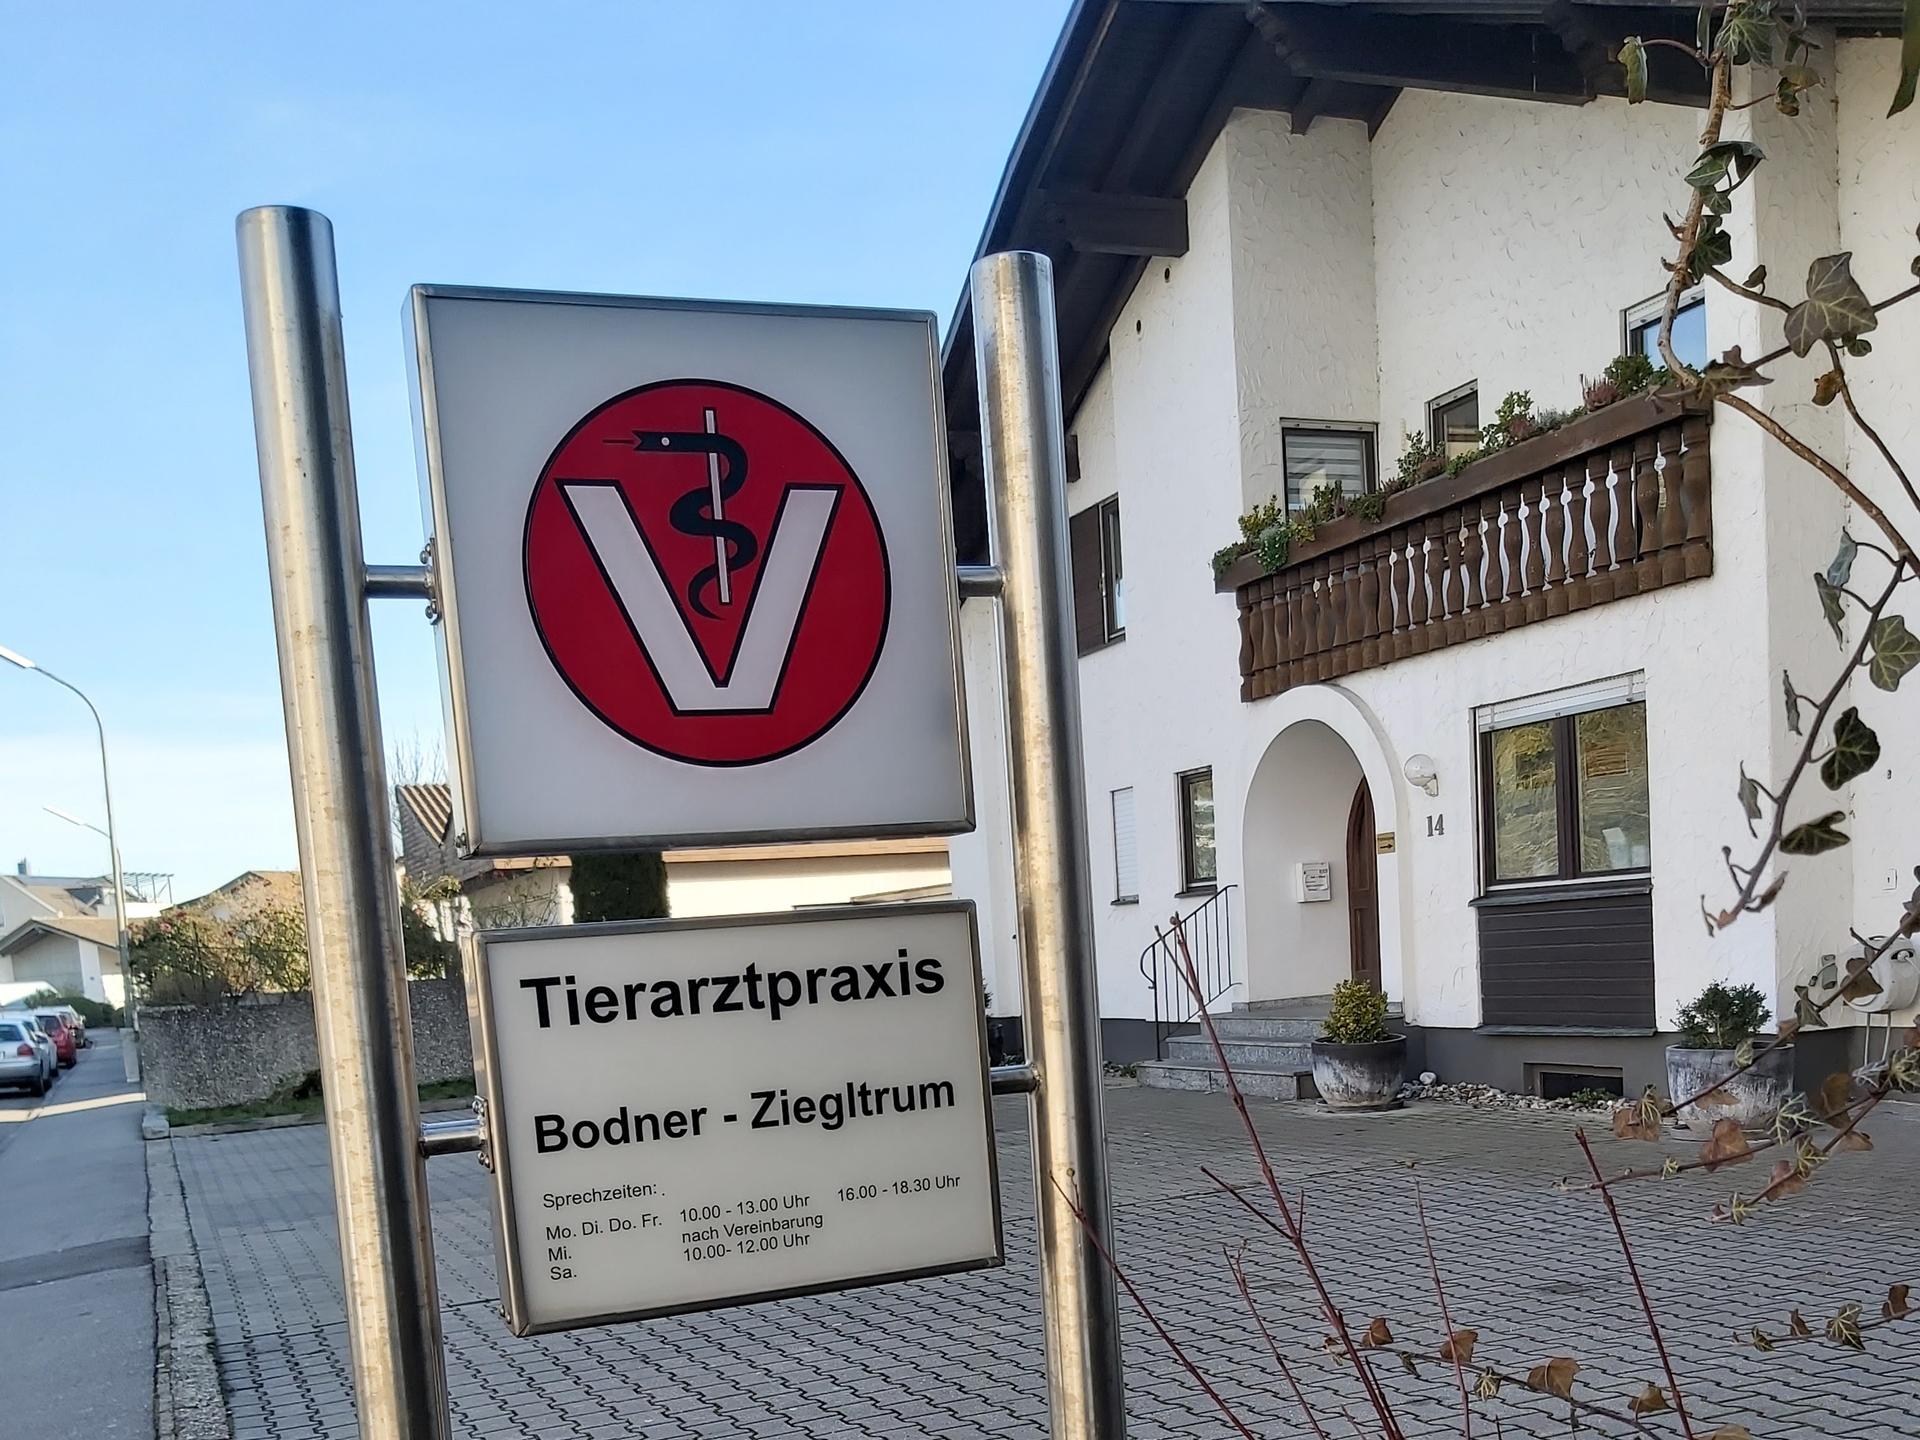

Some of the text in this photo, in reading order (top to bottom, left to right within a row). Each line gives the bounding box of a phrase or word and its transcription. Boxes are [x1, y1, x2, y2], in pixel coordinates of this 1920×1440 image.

[553, 477, 847, 717] V
[1426, 813, 1445, 837] 14
[519, 948, 946, 1029] Tierarztpraxis
[533, 1080, 956, 1154] Bodner - Ziegltrum
[543, 1183, 658, 1210] Sprechzeiten:
[837, 1184, 878, 1202] 16.00
[891, 1177, 931, 1195] 18.30
[935, 1174, 961, 1190] Uhr
[679, 1204, 721, 1223] 10.00
[736, 1197, 779, 1216] 13.00
[782, 1194, 811, 1209] Uhr
[545, 1213, 663, 1241] Mo. Di. Do. Fr.
[681, 1212, 824, 1244] nach Vereinbarung
[547, 1245, 572, 1263] Mi.
[736, 1235, 779, 1255] 12.00
[782, 1232, 811, 1248] Uhr
[550, 1265, 577, 1281] Sa.
